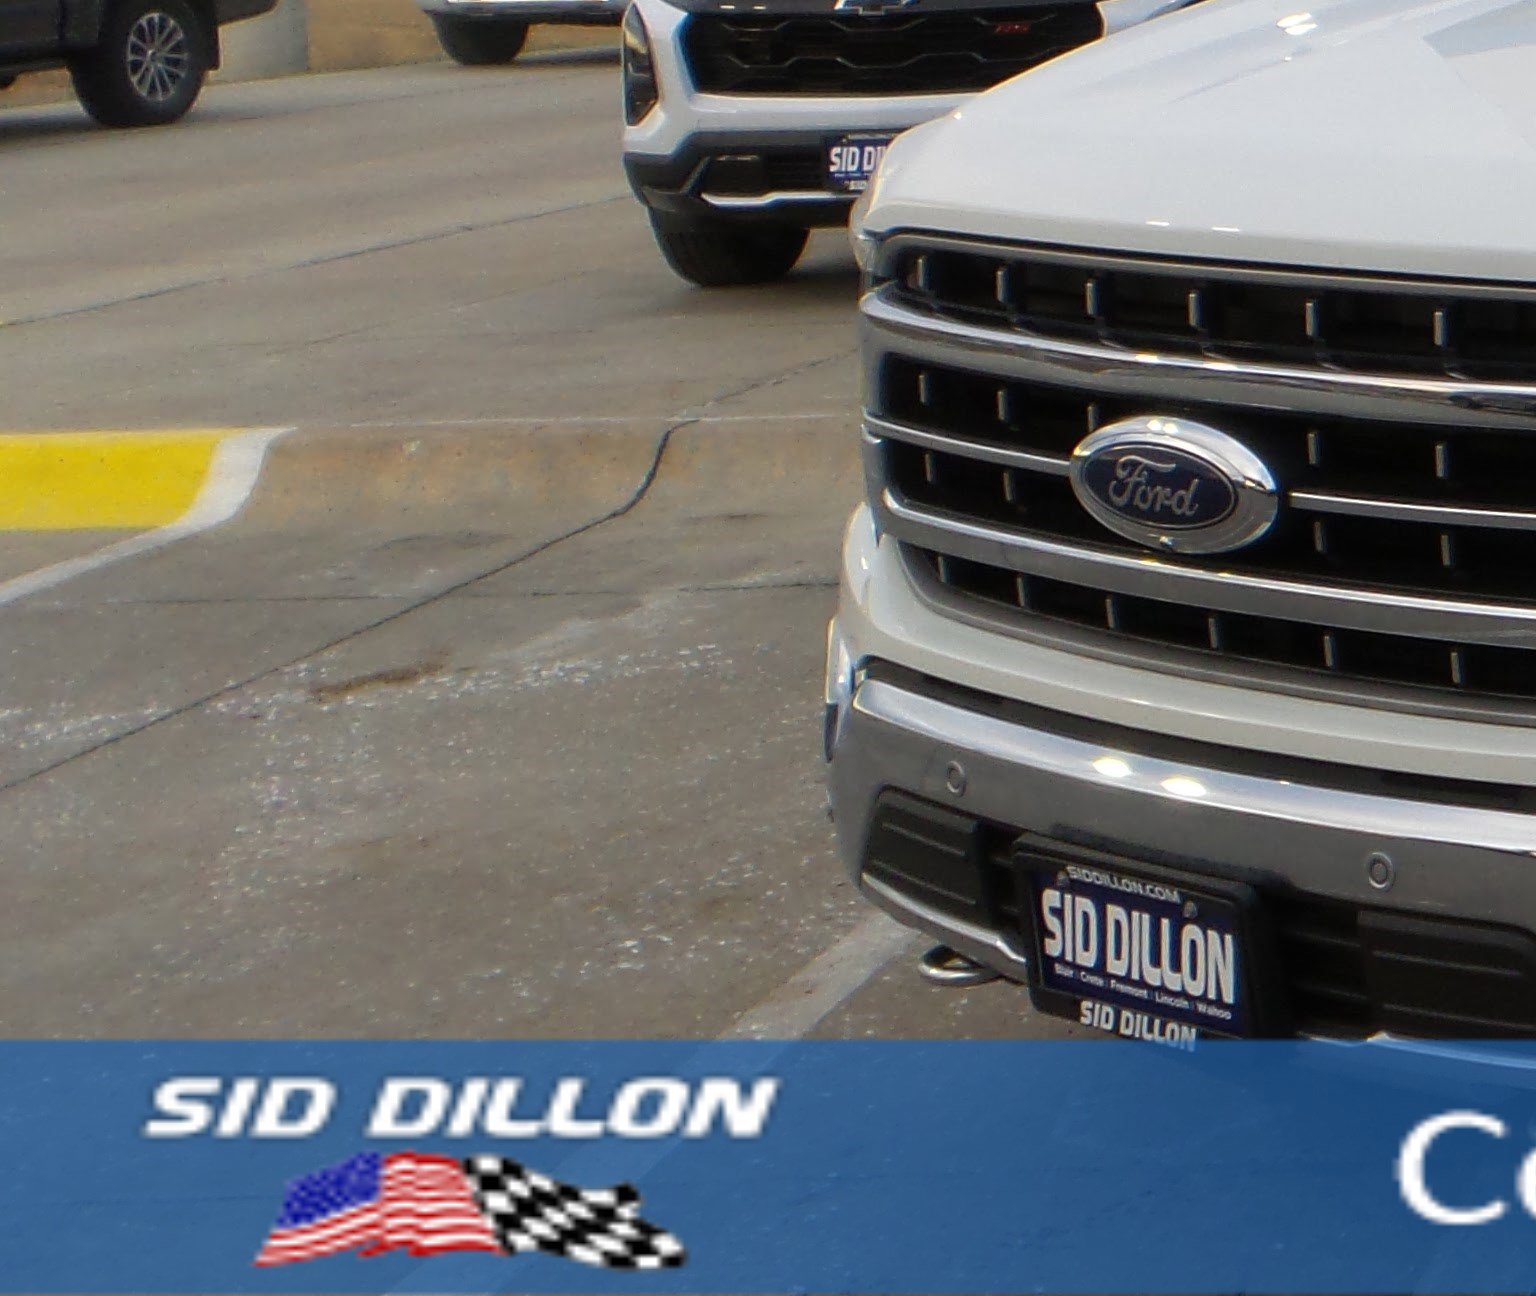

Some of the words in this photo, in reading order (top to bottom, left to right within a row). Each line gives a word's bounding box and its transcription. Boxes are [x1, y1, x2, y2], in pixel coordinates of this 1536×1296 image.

[829, 146, 860, 172] SID
[1108, 455, 1200, 517] Ford
[1065, 865, 1182, 904] SIDDILLON.COM
[1041, 888, 1098, 968] SID
[1105, 903, 1235, 1005] DILLON
[1155, 990, 1190, 1010] Lincoln
[1079, 1000, 1115, 1031] SID
[1119, 1009, 1197, 1053] DILLON
